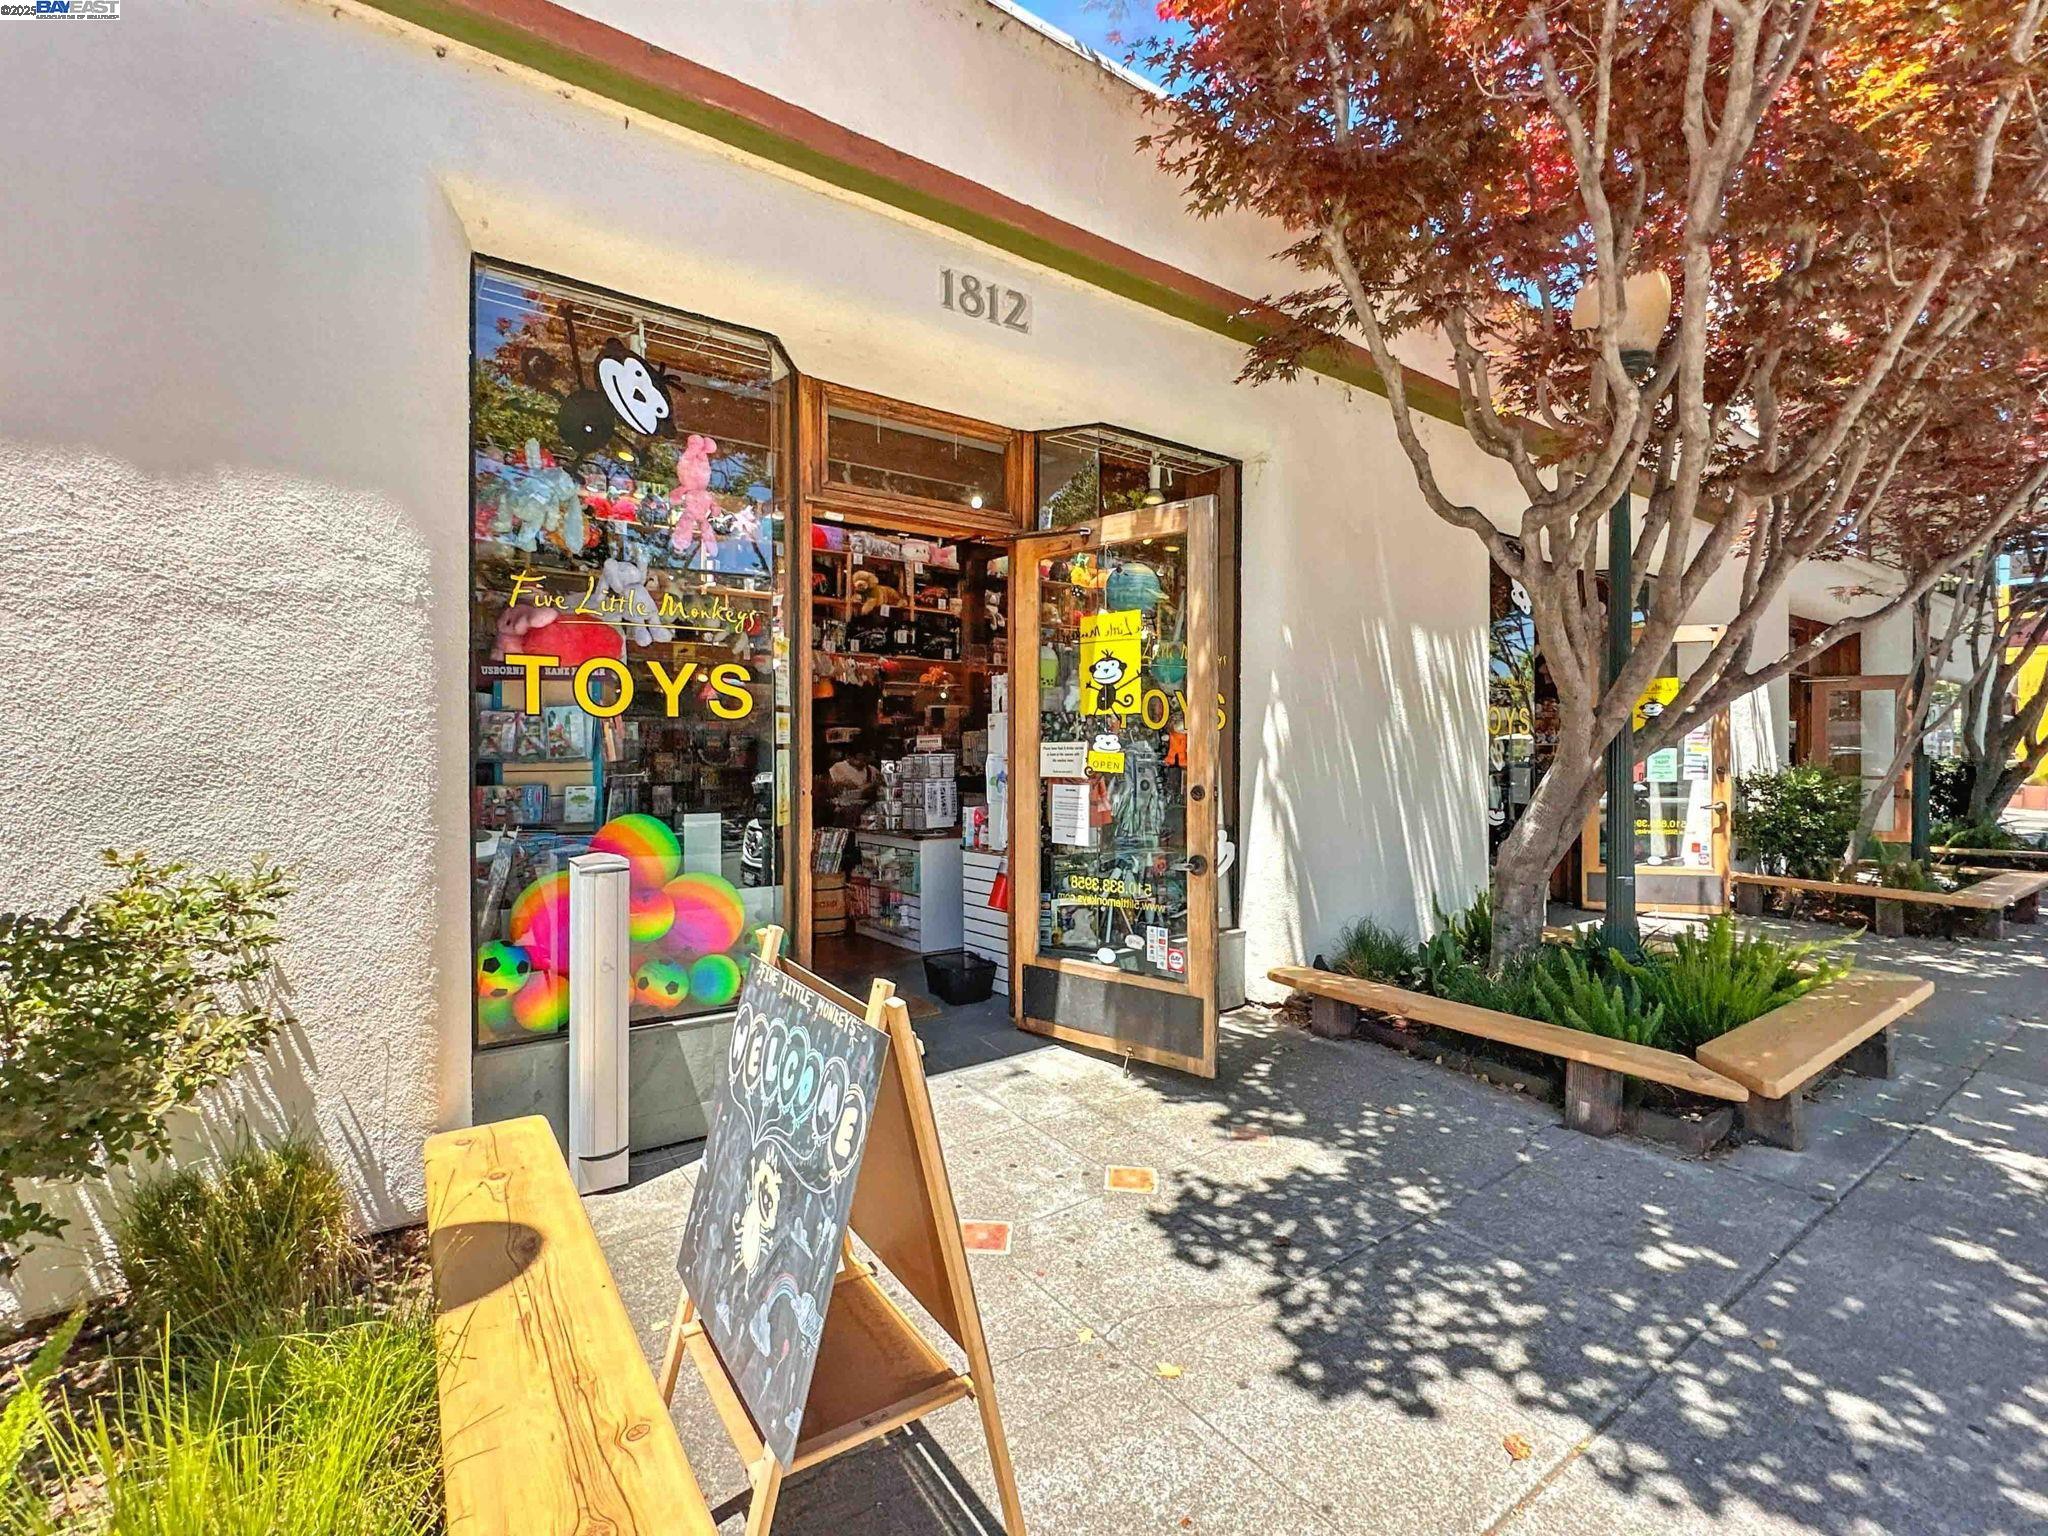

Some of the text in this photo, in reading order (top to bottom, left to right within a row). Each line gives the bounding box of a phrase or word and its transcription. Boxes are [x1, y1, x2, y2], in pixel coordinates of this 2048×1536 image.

[941, 269, 1029, 334] 1812
[510, 570, 757, 633] Five Little Monkeys
[505, 653, 754, 720] TOYS
[1092, 760, 1120, 770] OPEN
[781, 975, 815, 1010] LITTLE
[815, 997, 859, 1037] MONKEYS
[733, 1024, 860, 1158] WELCOME
